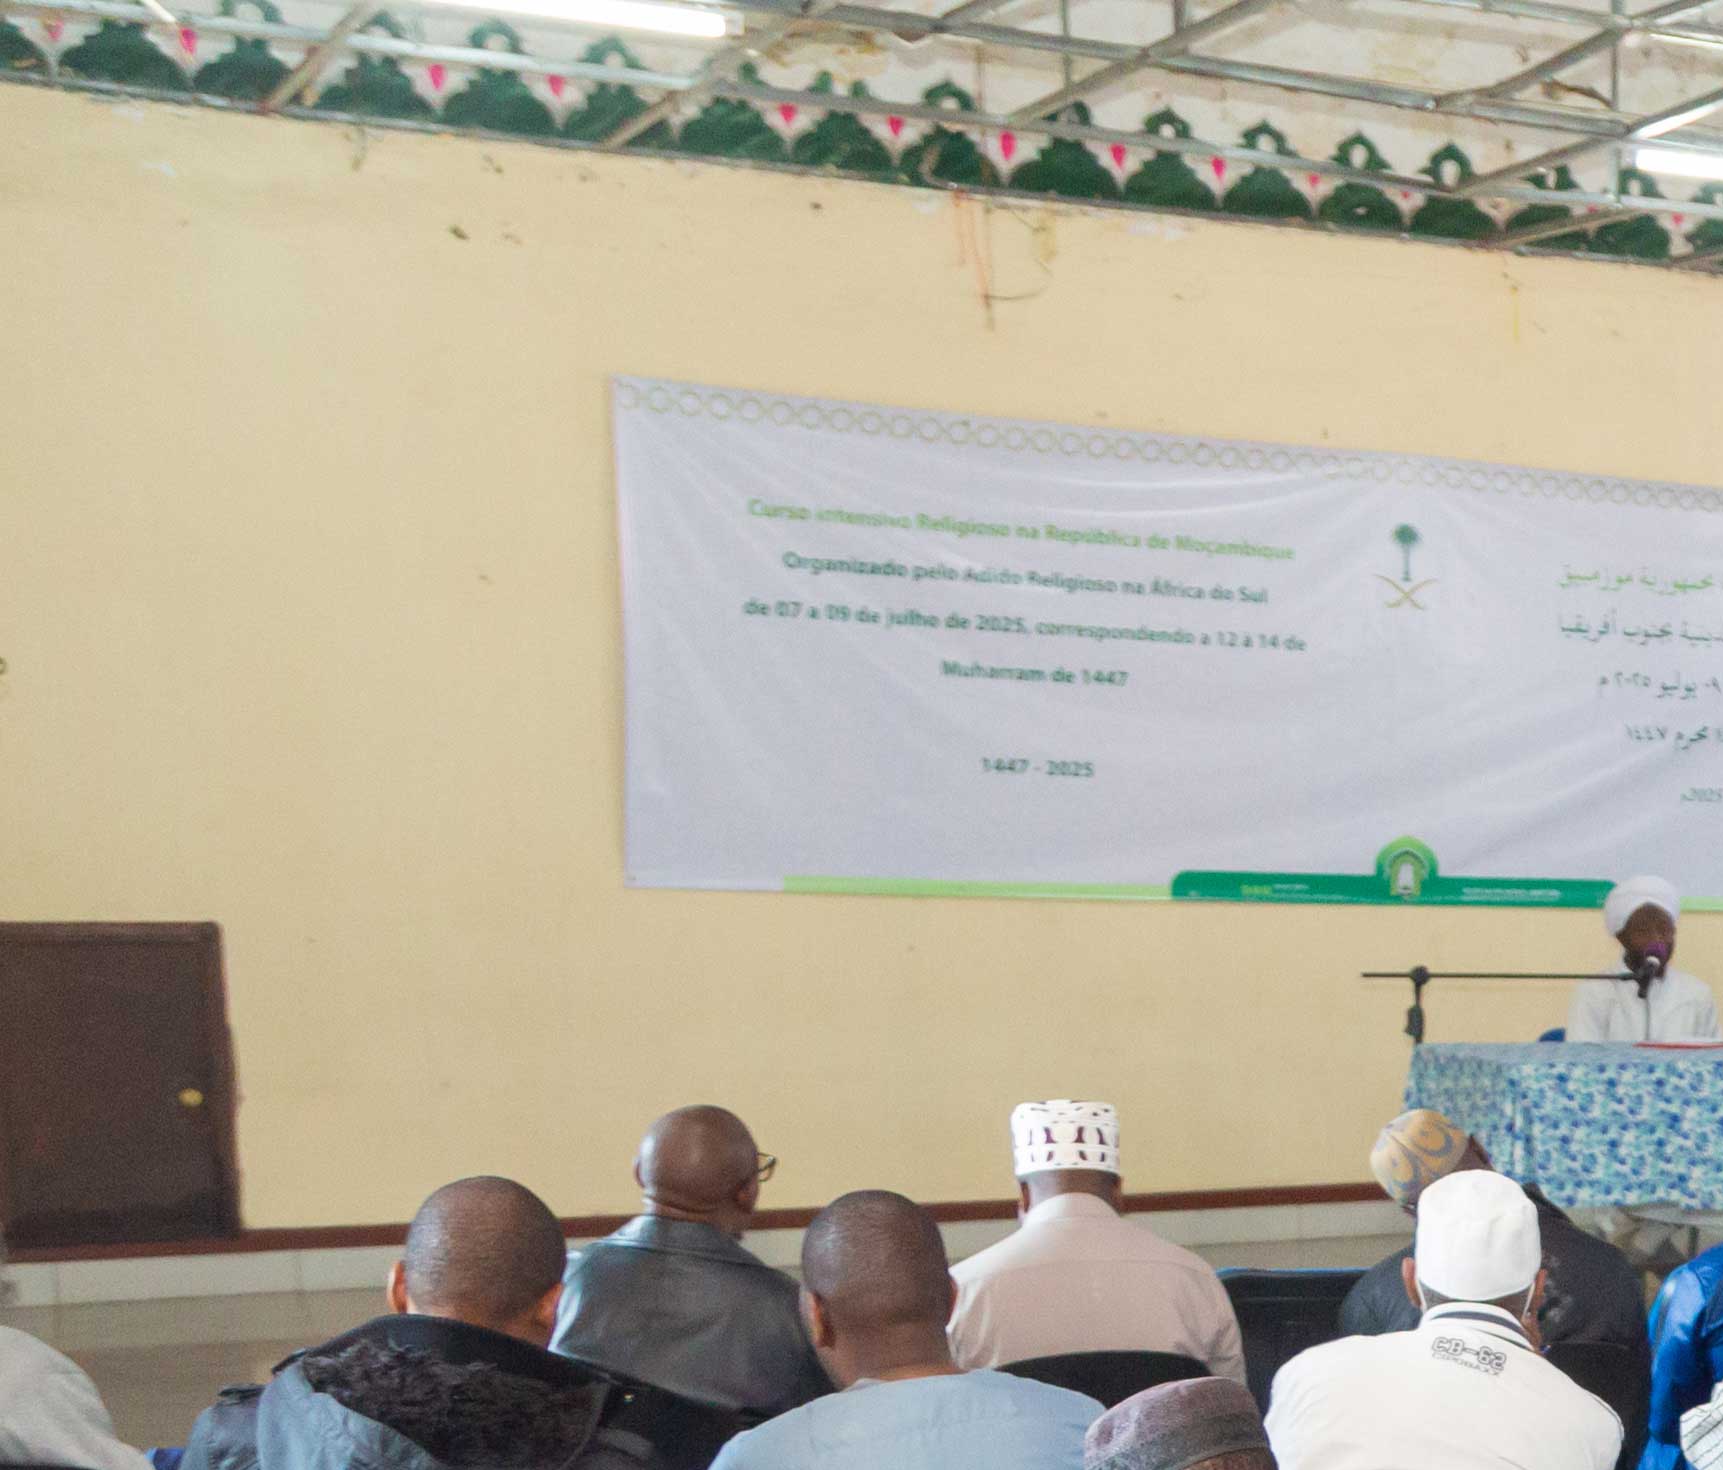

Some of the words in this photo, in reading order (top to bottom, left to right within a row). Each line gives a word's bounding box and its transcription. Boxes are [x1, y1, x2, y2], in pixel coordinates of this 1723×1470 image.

[749, 500, 809, 520] Curso
[915, 513, 1010, 538] Religioso
[1015, 525, 1039, 540] na
[1147, 533, 1169, 550] de
[1175, 534, 1295, 560] Moçambique
[782, 550, 907, 575] Organizado
[912, 564, 959, 582] pelo
[1026, 570, 1118, 592] Religioso
[1122, 581, 1145, 595] na
[1150, 575, 1207, 599] África
[1239, 586, 1269, 603] Sul
[744, 599, 769, 615] de
[773, 600, 802, 617] 07
[806, 605, 821, 620] a
[825, 603, 850, 621] 09
[854, 607, 880, 623] de
[944, 612, 970, 628] de
[1035, 622, 1195, 642] correspondendo
[1215, 631, 1238, 647] 12
[1257, 633, 1280, 649] 14
[1283, 633, 1306, 651] de
[942, 660, 1045, 680] Muharram
[1050, 667, 1075, 683] de
[1080, 668, 1129, 686] 1447
[982, 757, 1029, 773] 1447
[1047, 759, 1094, 777] 2025
[1432, 1336, 1507, 1371] CB-62
